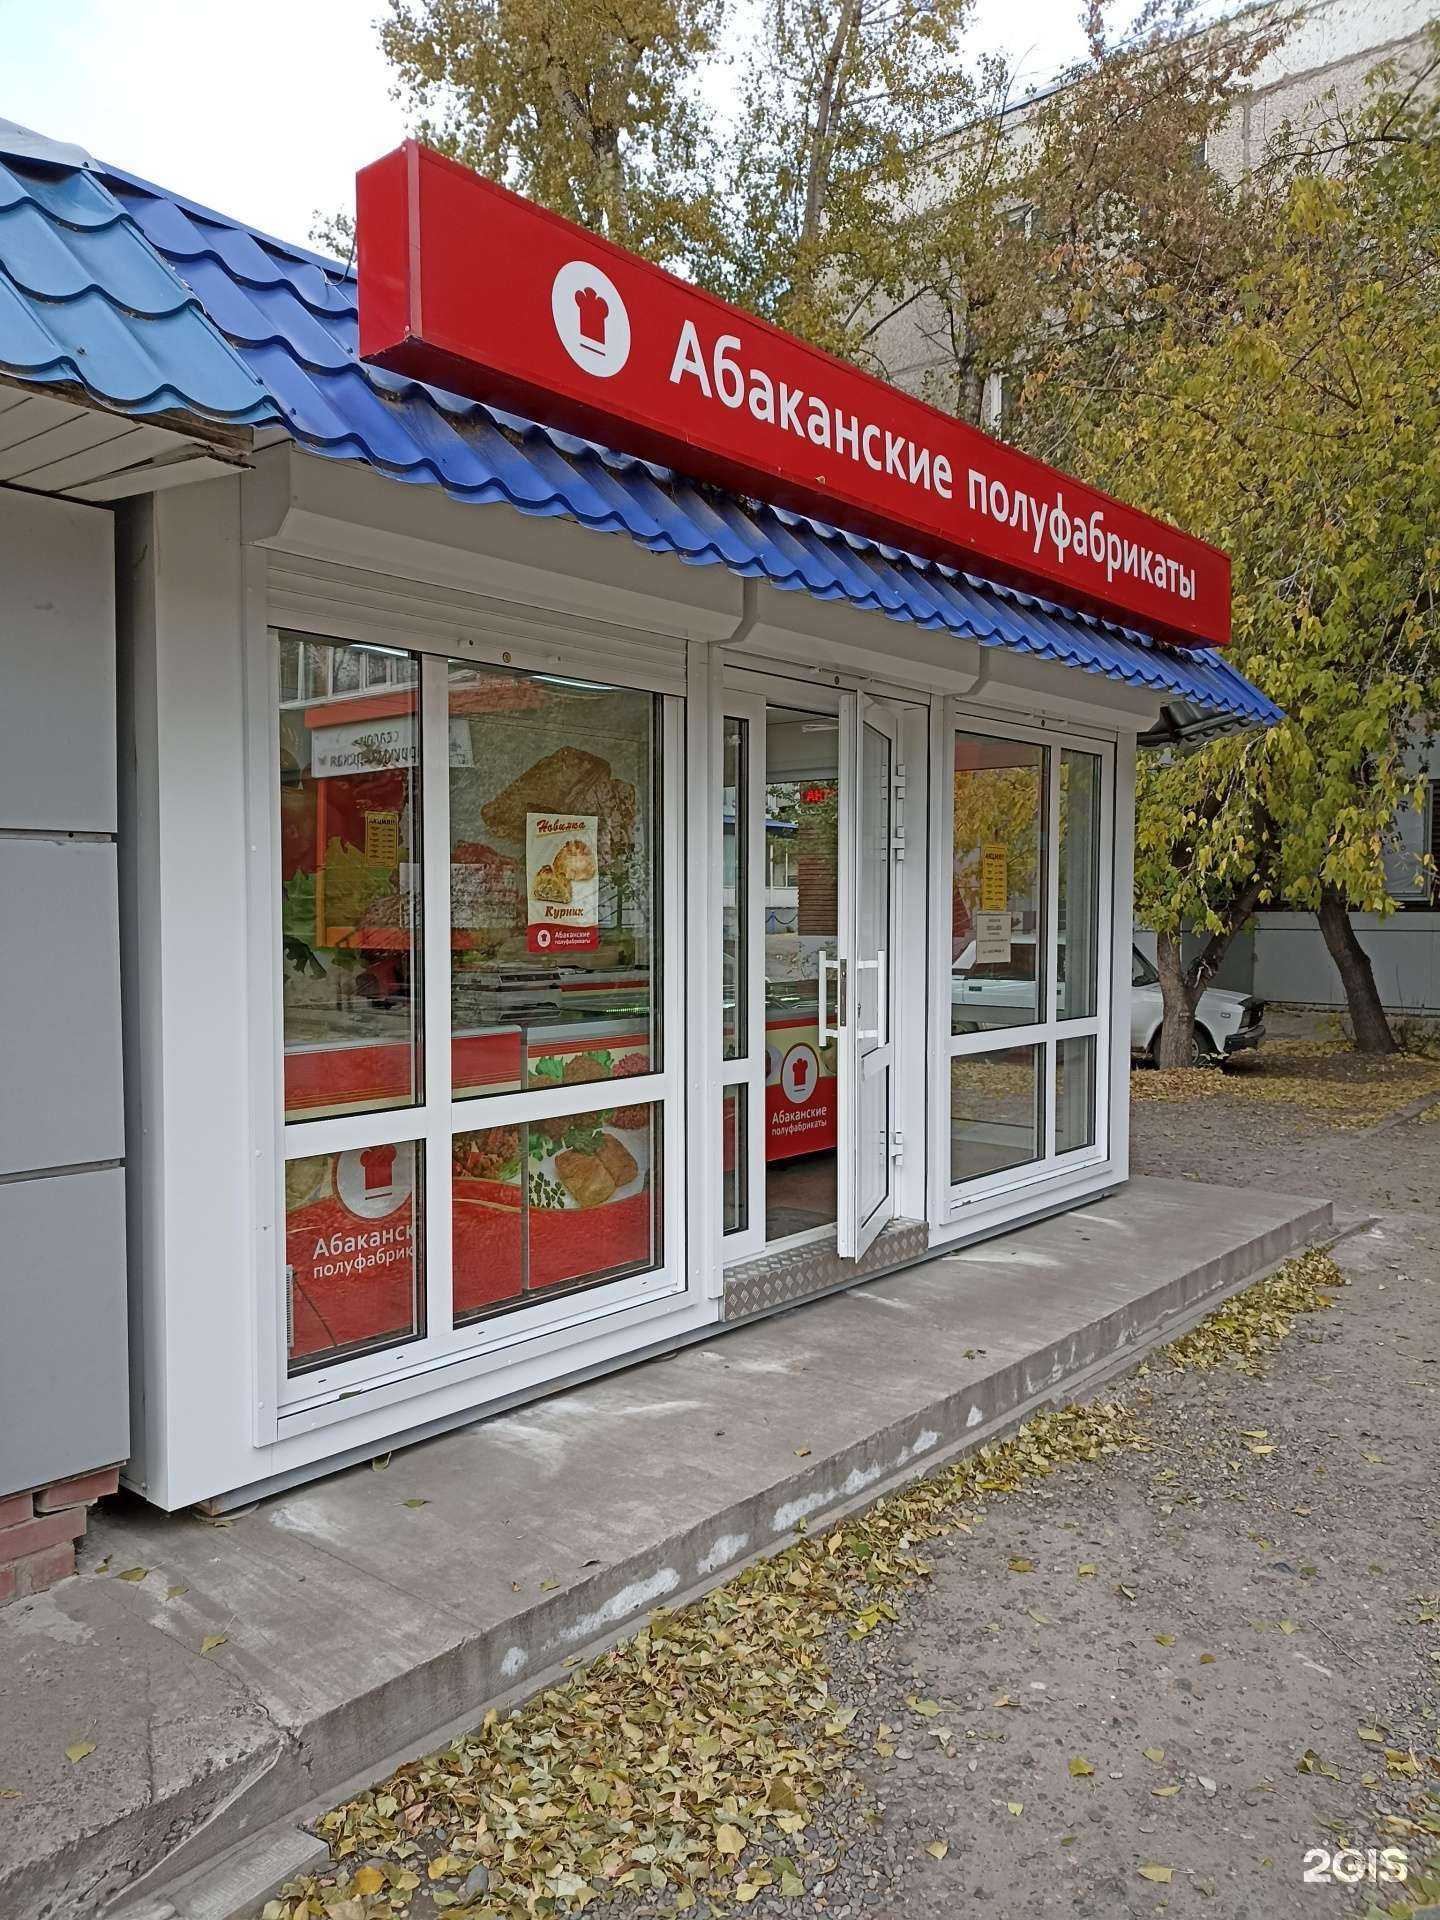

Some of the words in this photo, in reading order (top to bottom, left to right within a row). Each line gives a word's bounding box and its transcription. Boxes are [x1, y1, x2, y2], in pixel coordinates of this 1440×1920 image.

[668, 319, 953, 500] Абаканские
[968, 468, 1197, 602] полуфабрикаты
[536, 818, 587, 833] Новинка
[544, 905, 584, 919] Курник
[771, 1106, 828, 1125] Абаканские
[771, 1119, 828, 1136] полуфабрикаты
